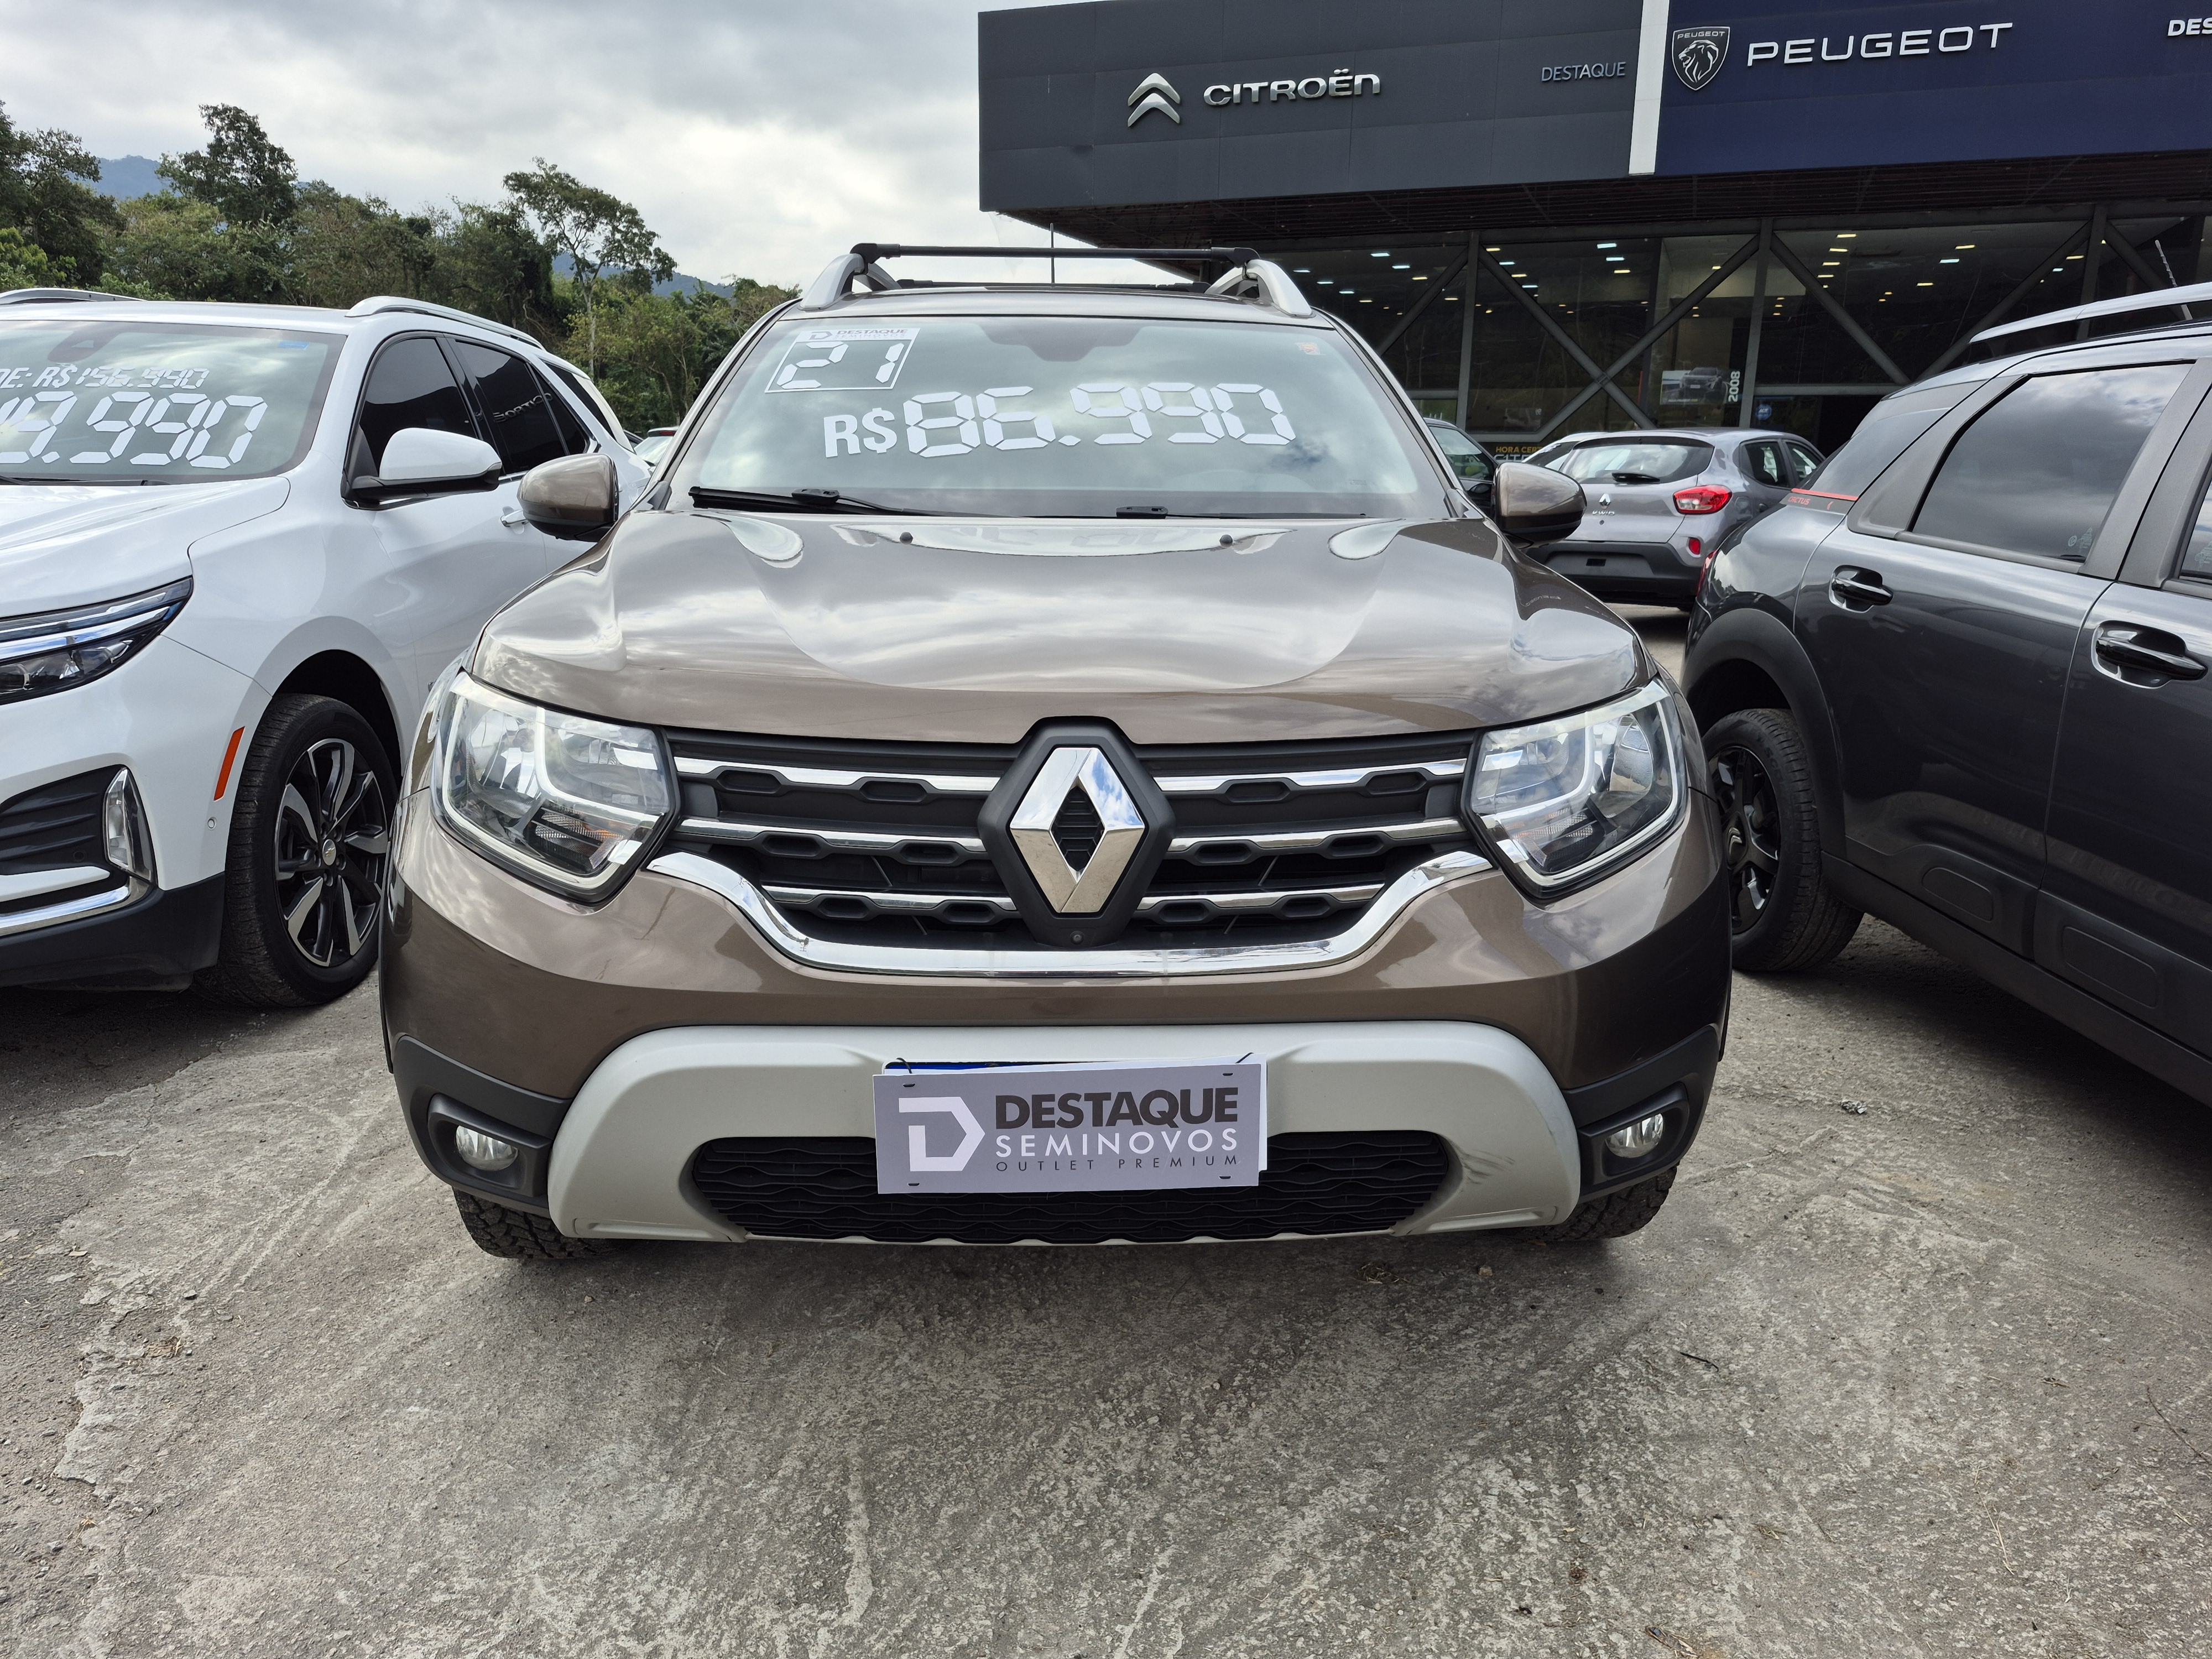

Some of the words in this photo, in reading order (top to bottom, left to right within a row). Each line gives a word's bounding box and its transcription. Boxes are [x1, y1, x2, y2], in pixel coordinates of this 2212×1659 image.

[1677, 31, 1725, 40] PEUGEOT
[2168, 17, 2212, 36] DES
[1747, 22, 2013, 66] PEUGEOT
[1542, 61, 1626, 81] DESTAQUE
[1203, 68, 1380, 106] CITROËN
[776, 341, 904, 389] 21
[1728, 371, 1741, 402] 2008
[0, 390, 268, 469] 9.990
[1788, 496, 1811, 505] CACTUS
[995, 1087, 1238, 1129] DESTAQUE
[995, 1128, 1237, 1157] SEMINOVOS
[996, 1160, 1094, 1171] OUTLET
[1118, 1155, 1237, 1168] PREMIUM
